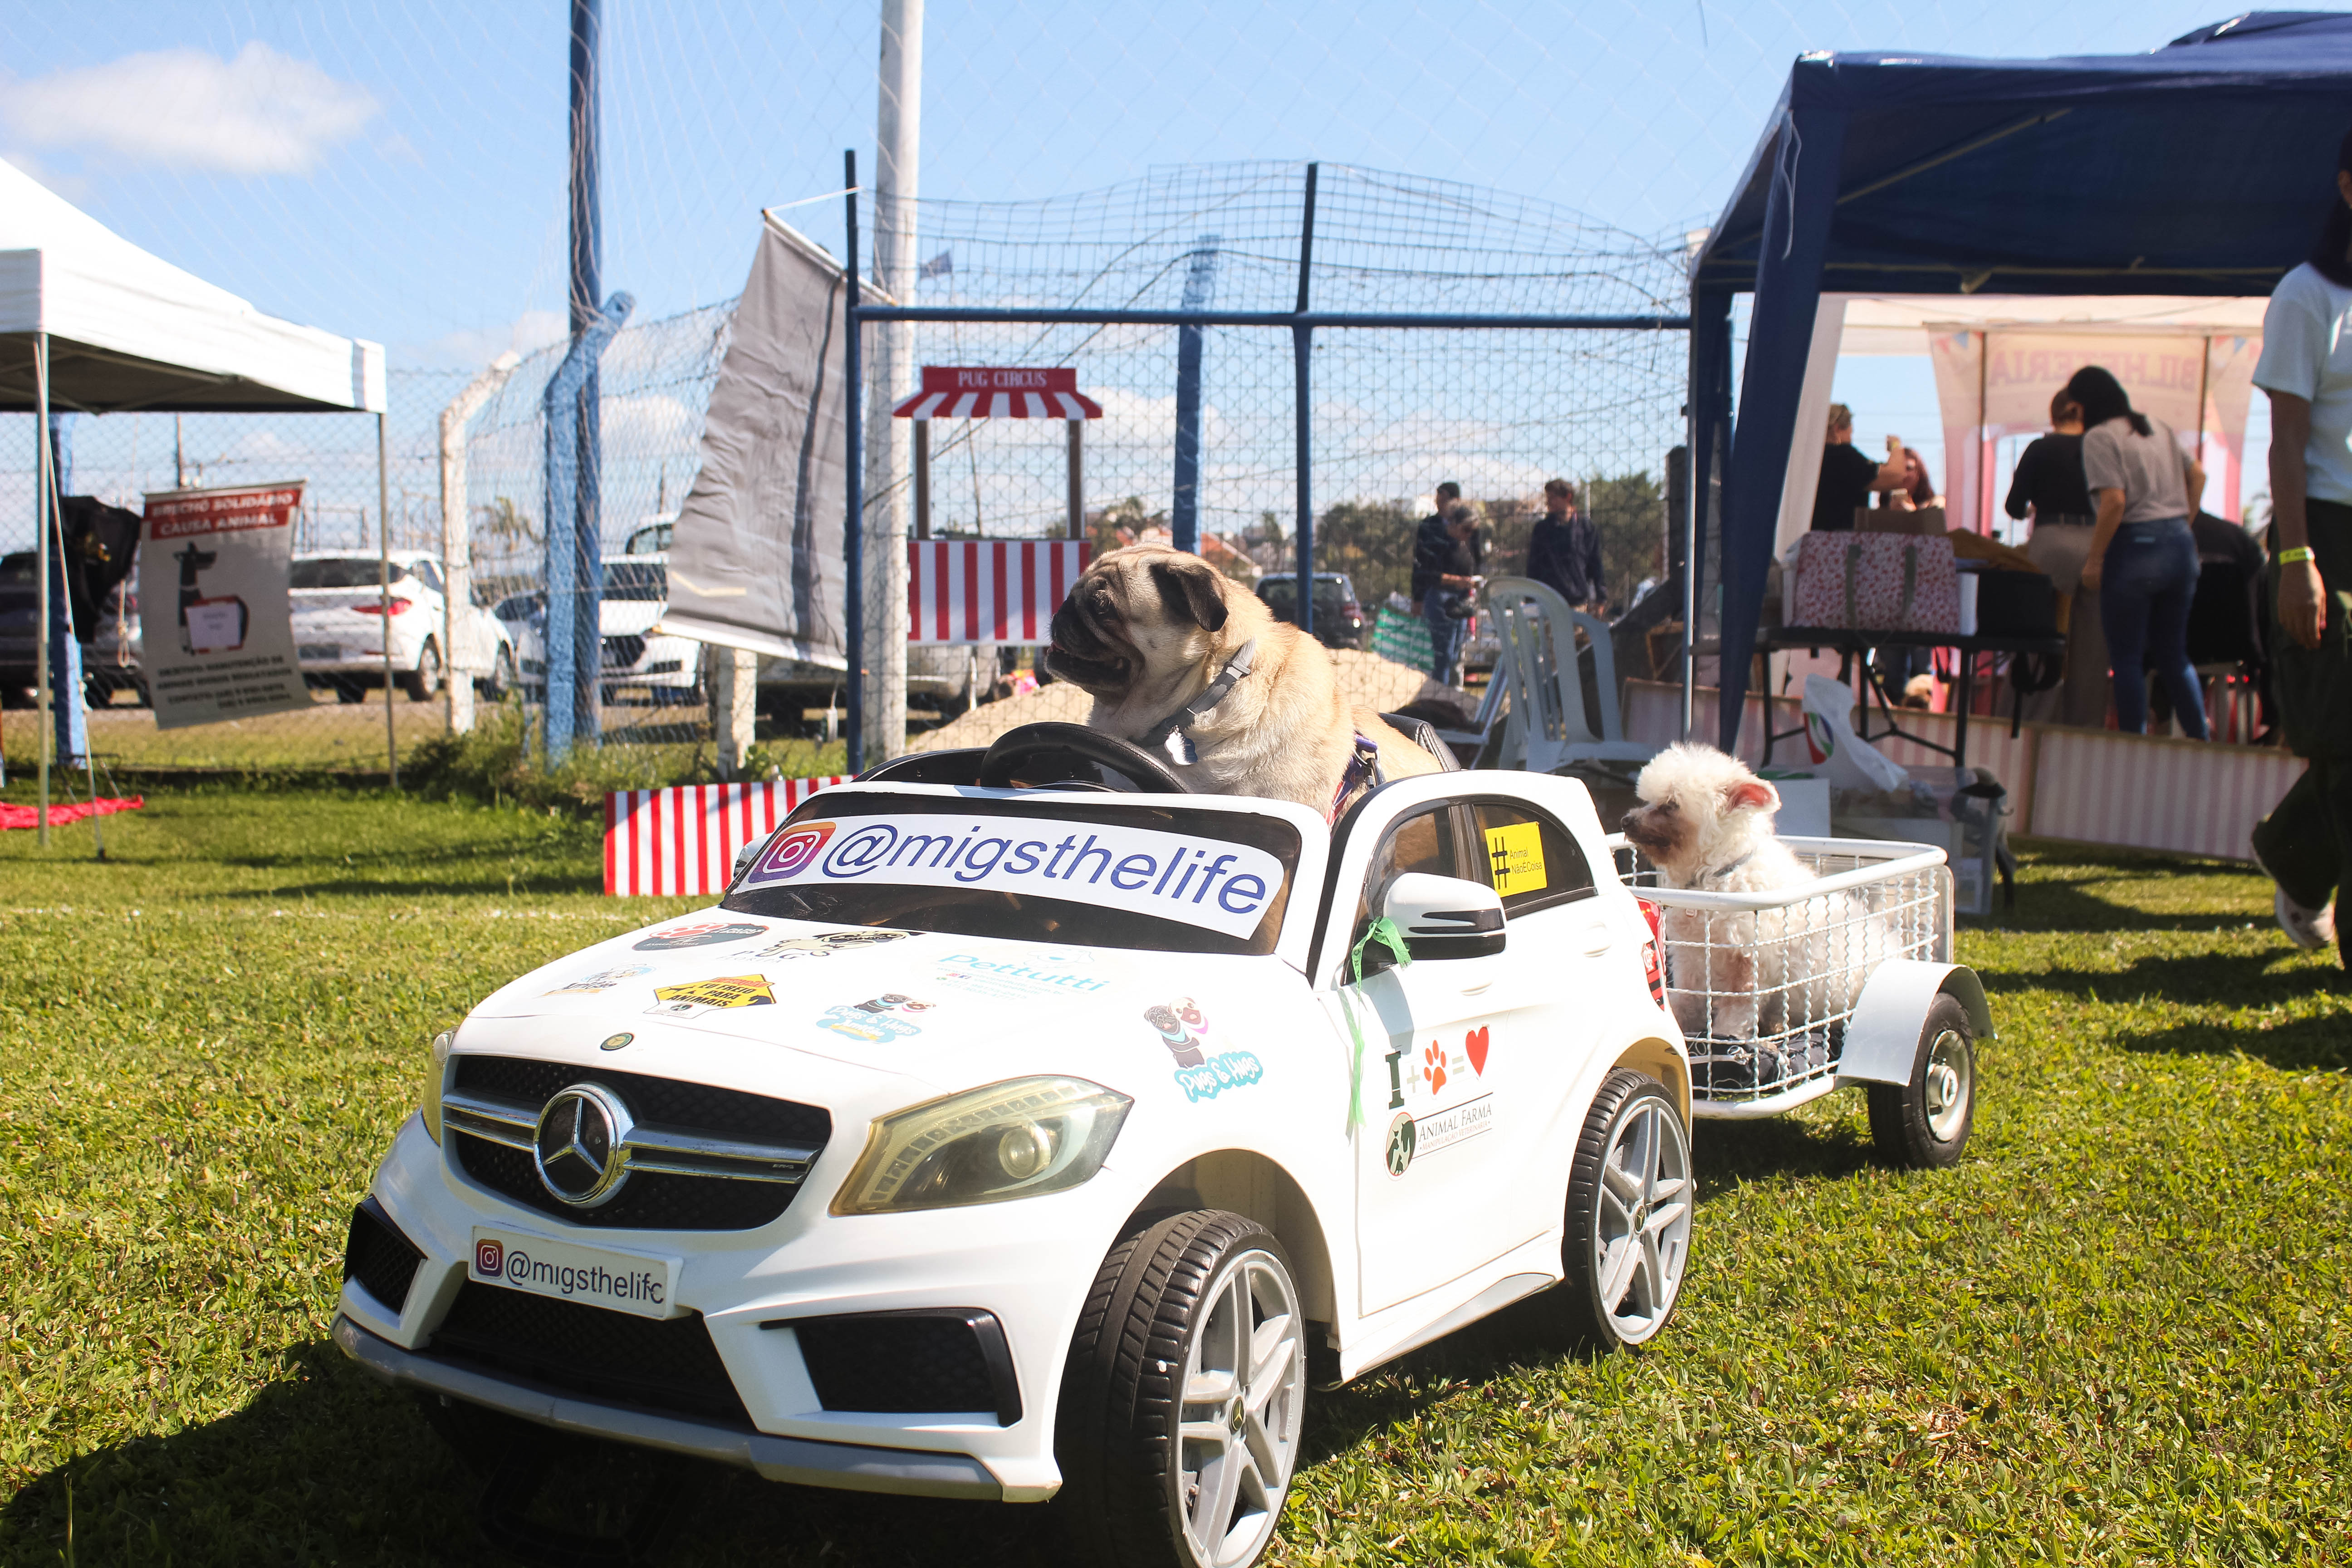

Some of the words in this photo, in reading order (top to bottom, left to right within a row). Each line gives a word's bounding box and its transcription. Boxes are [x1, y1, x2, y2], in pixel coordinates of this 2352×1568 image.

[958, 370, 988, 387] PUG
[994, 370, 1047, 387] CIRCUS
[213, 491, 294, 511] SOLIDÁRIO
[160, 519, 211, 536] CAUSA
[216, 513, 278, 529] ANIMAL
[1510, 847, 1529, 860] Animal
[822, 824, 1266, 914] @migsthelife
[1512, 860, 1542, 875] NãoÉCoisa
[938, 955, 1110, 991] Pettutti
[702, 990, 742, 1000] PARA
[716, 984, 756, 994] FREIO
[666, 995, 733, 1008] ANIMAIS
[830, 1006, 867, 1020] Pugs
[865, 1014, 882, 1024] &
[880, 1019, 917, 1034] Hugs
[1179, 1071, 1218, 1097] Pugs
[1210, 1061, 1231, 1084] &
[1223, 1056, 1260, 1082] Hugs
[1418, 1115, 1458, 1142] ANIMAL
[1461, 1103, 1492, 1127] FARMA
